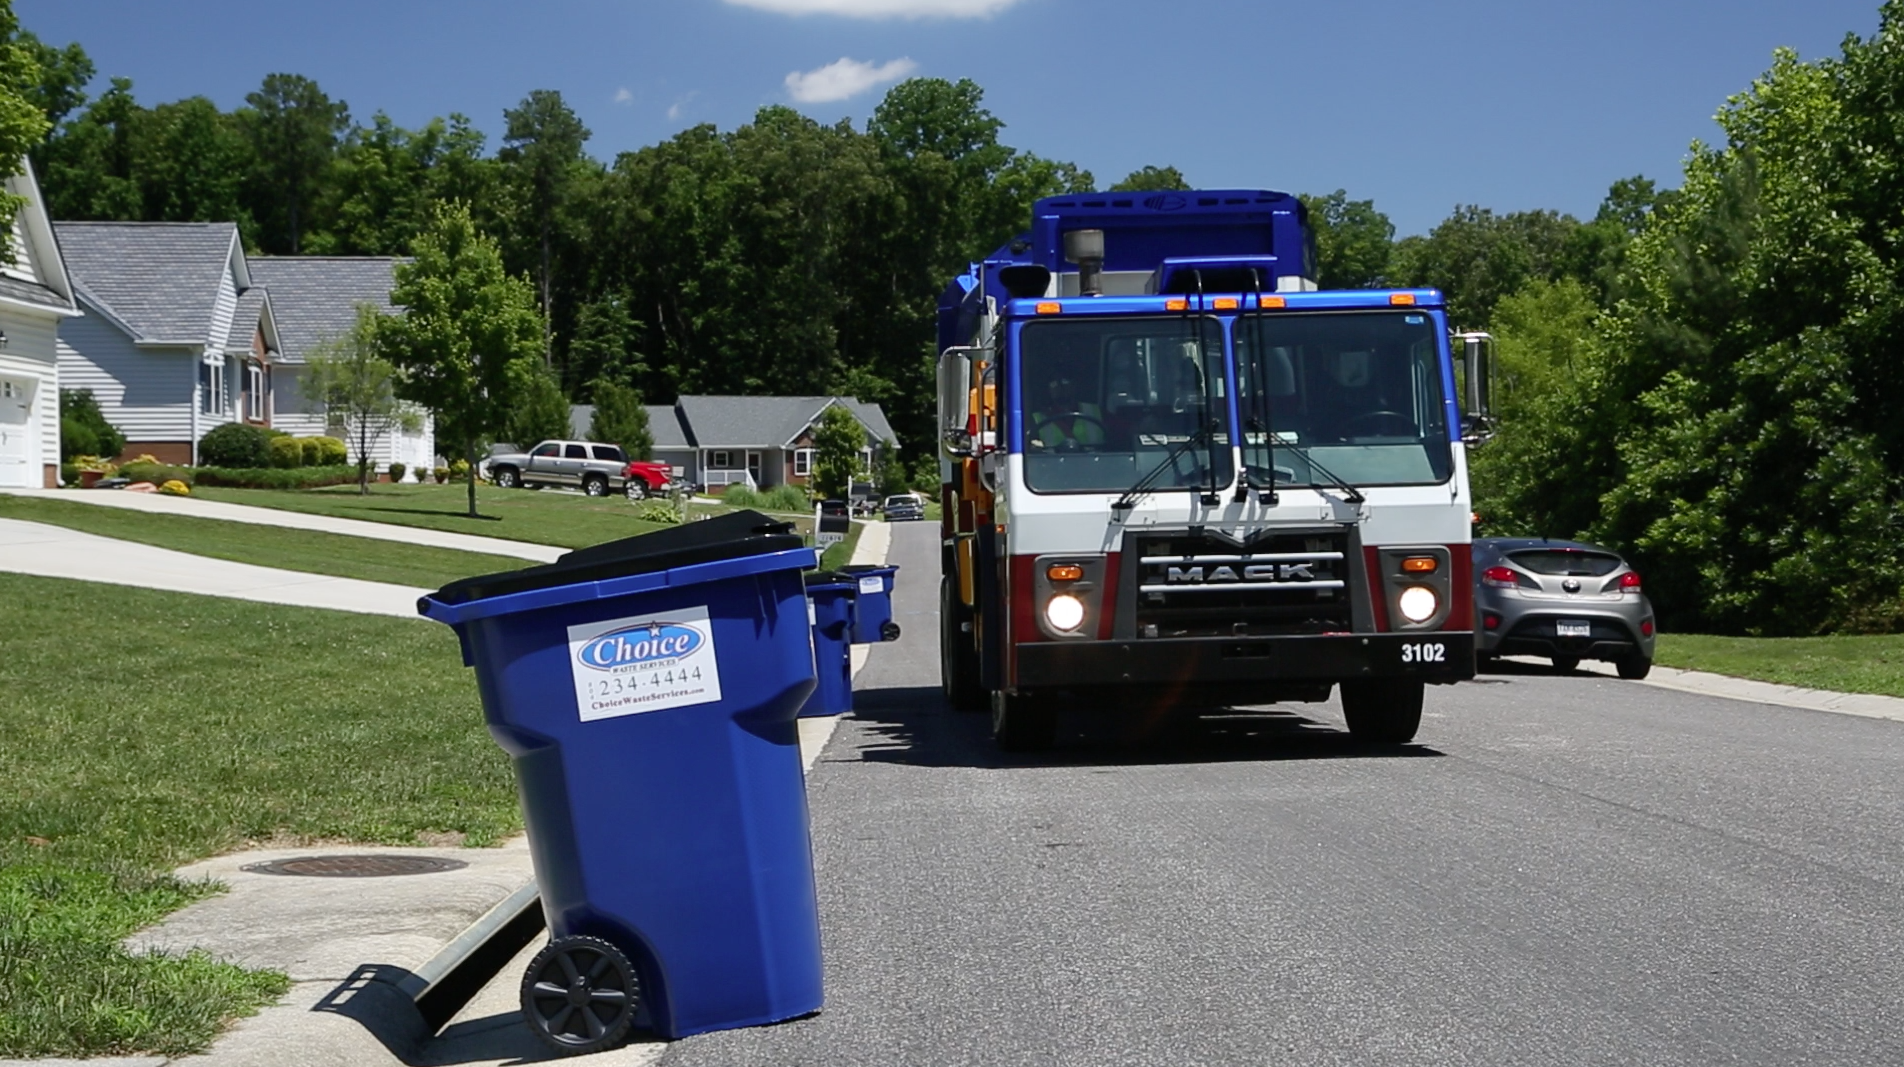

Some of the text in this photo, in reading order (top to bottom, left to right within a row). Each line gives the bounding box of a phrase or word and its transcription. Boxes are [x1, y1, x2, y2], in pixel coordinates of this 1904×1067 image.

[1168, 563, 1315, 582] MACK
[593, 633, 690, 665] Choice
[1401, 643, 1446, 663] 3102
[612, 659, 676, 674] WASTE SERVICES
[591, 687, 705, 711] ChoiceWasteServices.com
